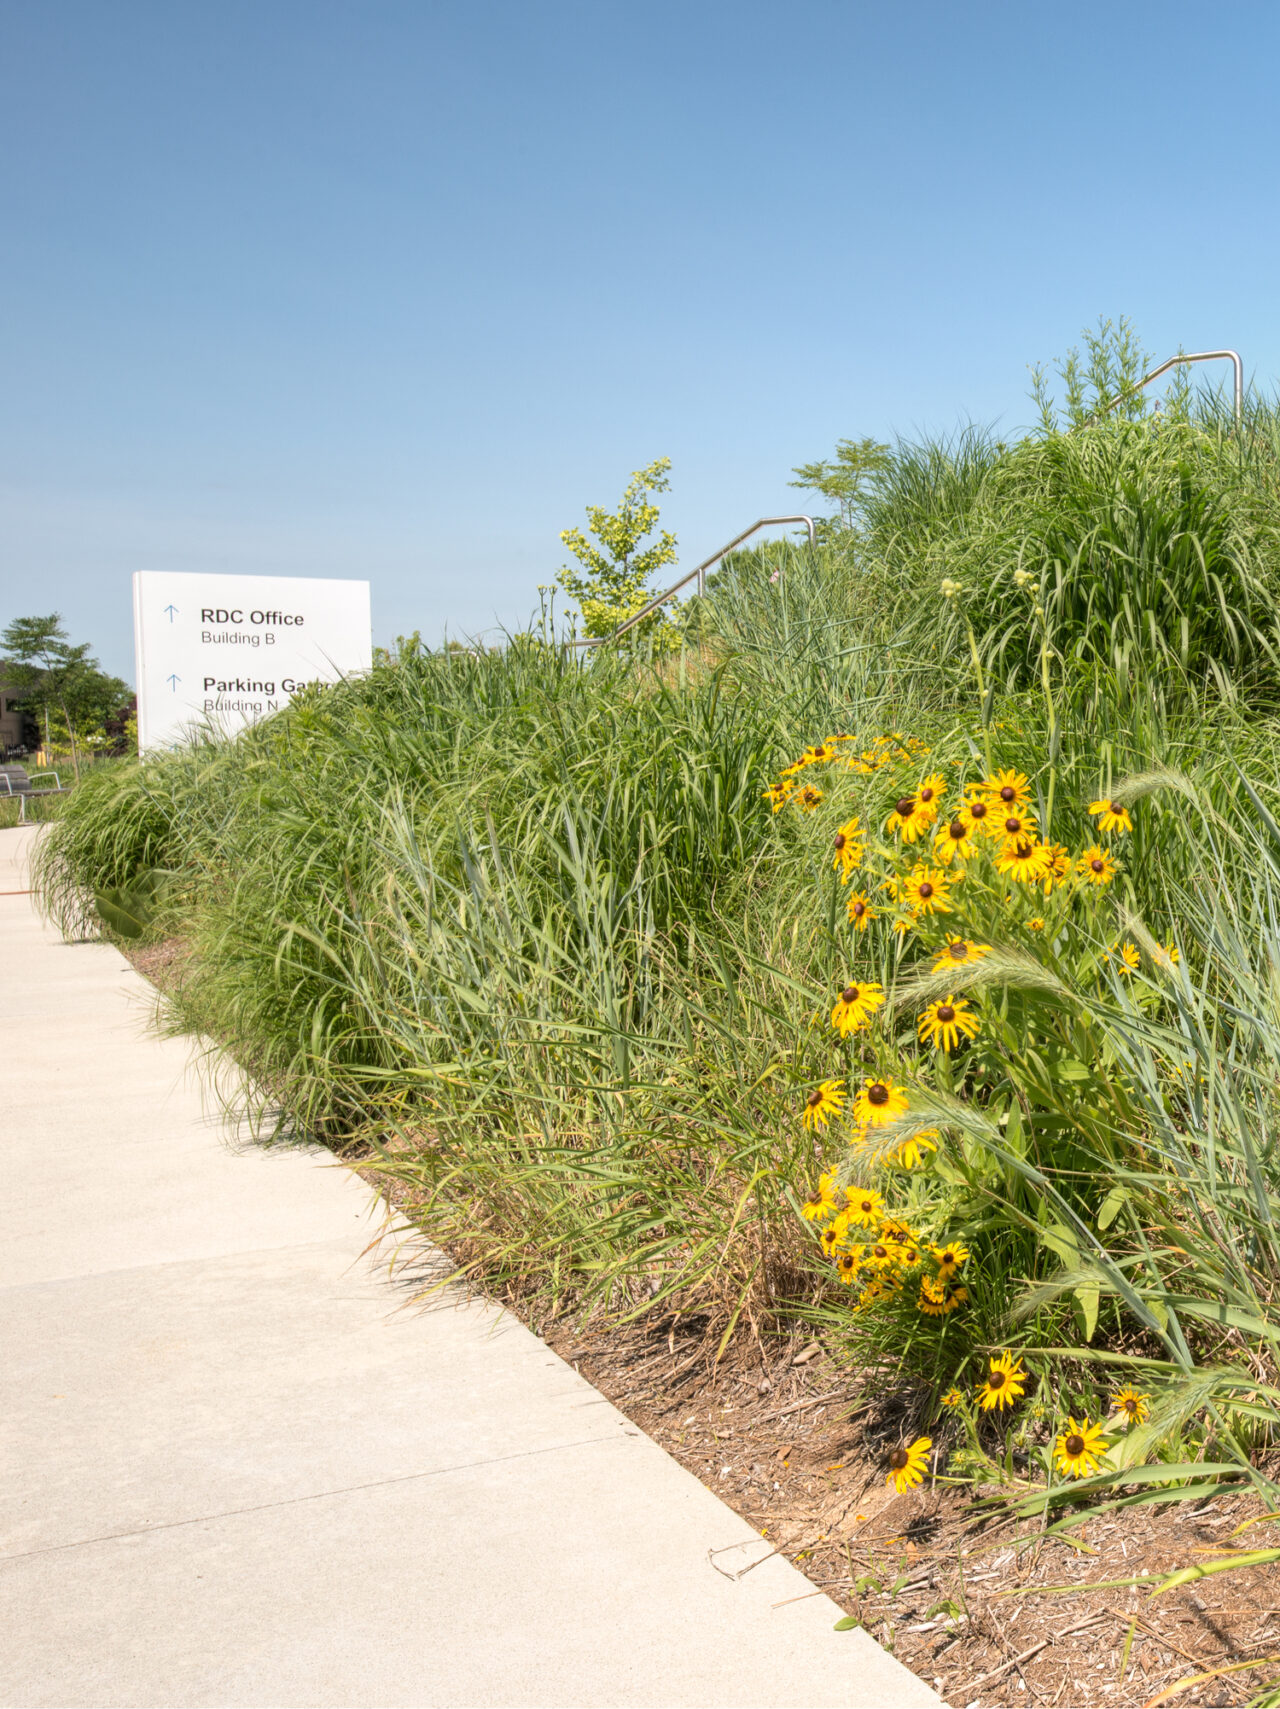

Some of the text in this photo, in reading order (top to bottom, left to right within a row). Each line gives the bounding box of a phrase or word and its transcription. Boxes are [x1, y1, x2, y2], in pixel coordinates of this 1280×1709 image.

[201, 608, 305, 626] RDC Office
[201, 631, 276, 647] Building B
[203, 677, 275, 696] Parking
[204, 699, 279, 714] Building N
